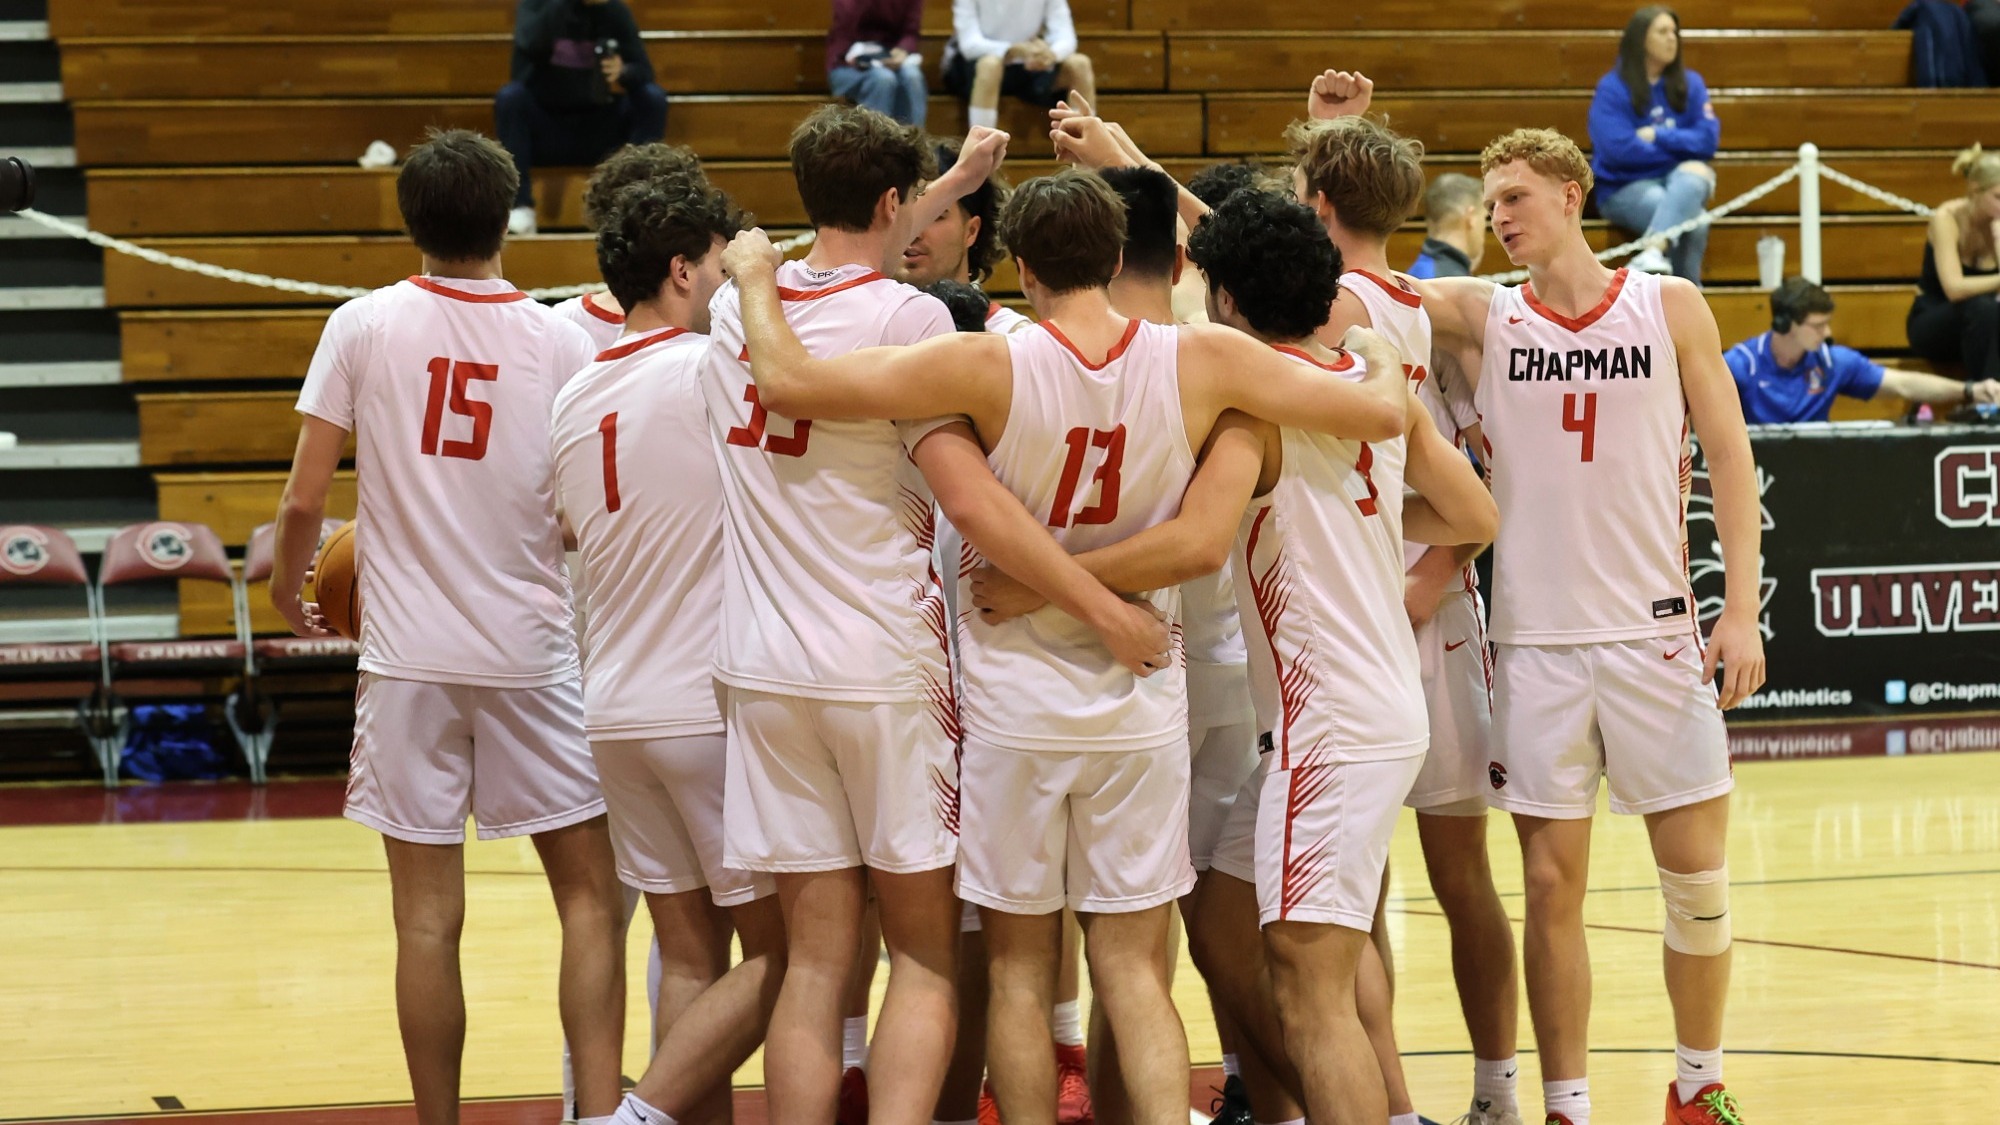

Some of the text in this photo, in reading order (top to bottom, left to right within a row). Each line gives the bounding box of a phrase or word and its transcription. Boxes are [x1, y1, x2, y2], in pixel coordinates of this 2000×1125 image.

[1508, 345, 1651, 381] CHAPMAN
[420, 356, 499, 461] 15
[1562, 392, 1597, 462] 4
[598, 411, 621, 514] 1
[1048, 422, 1126, 529] 13
[1934, 444, 2000, 528] C
[1811, 561, 2000, 637] UNIVE
[1909, 682, 2000, 705] @Chapm
